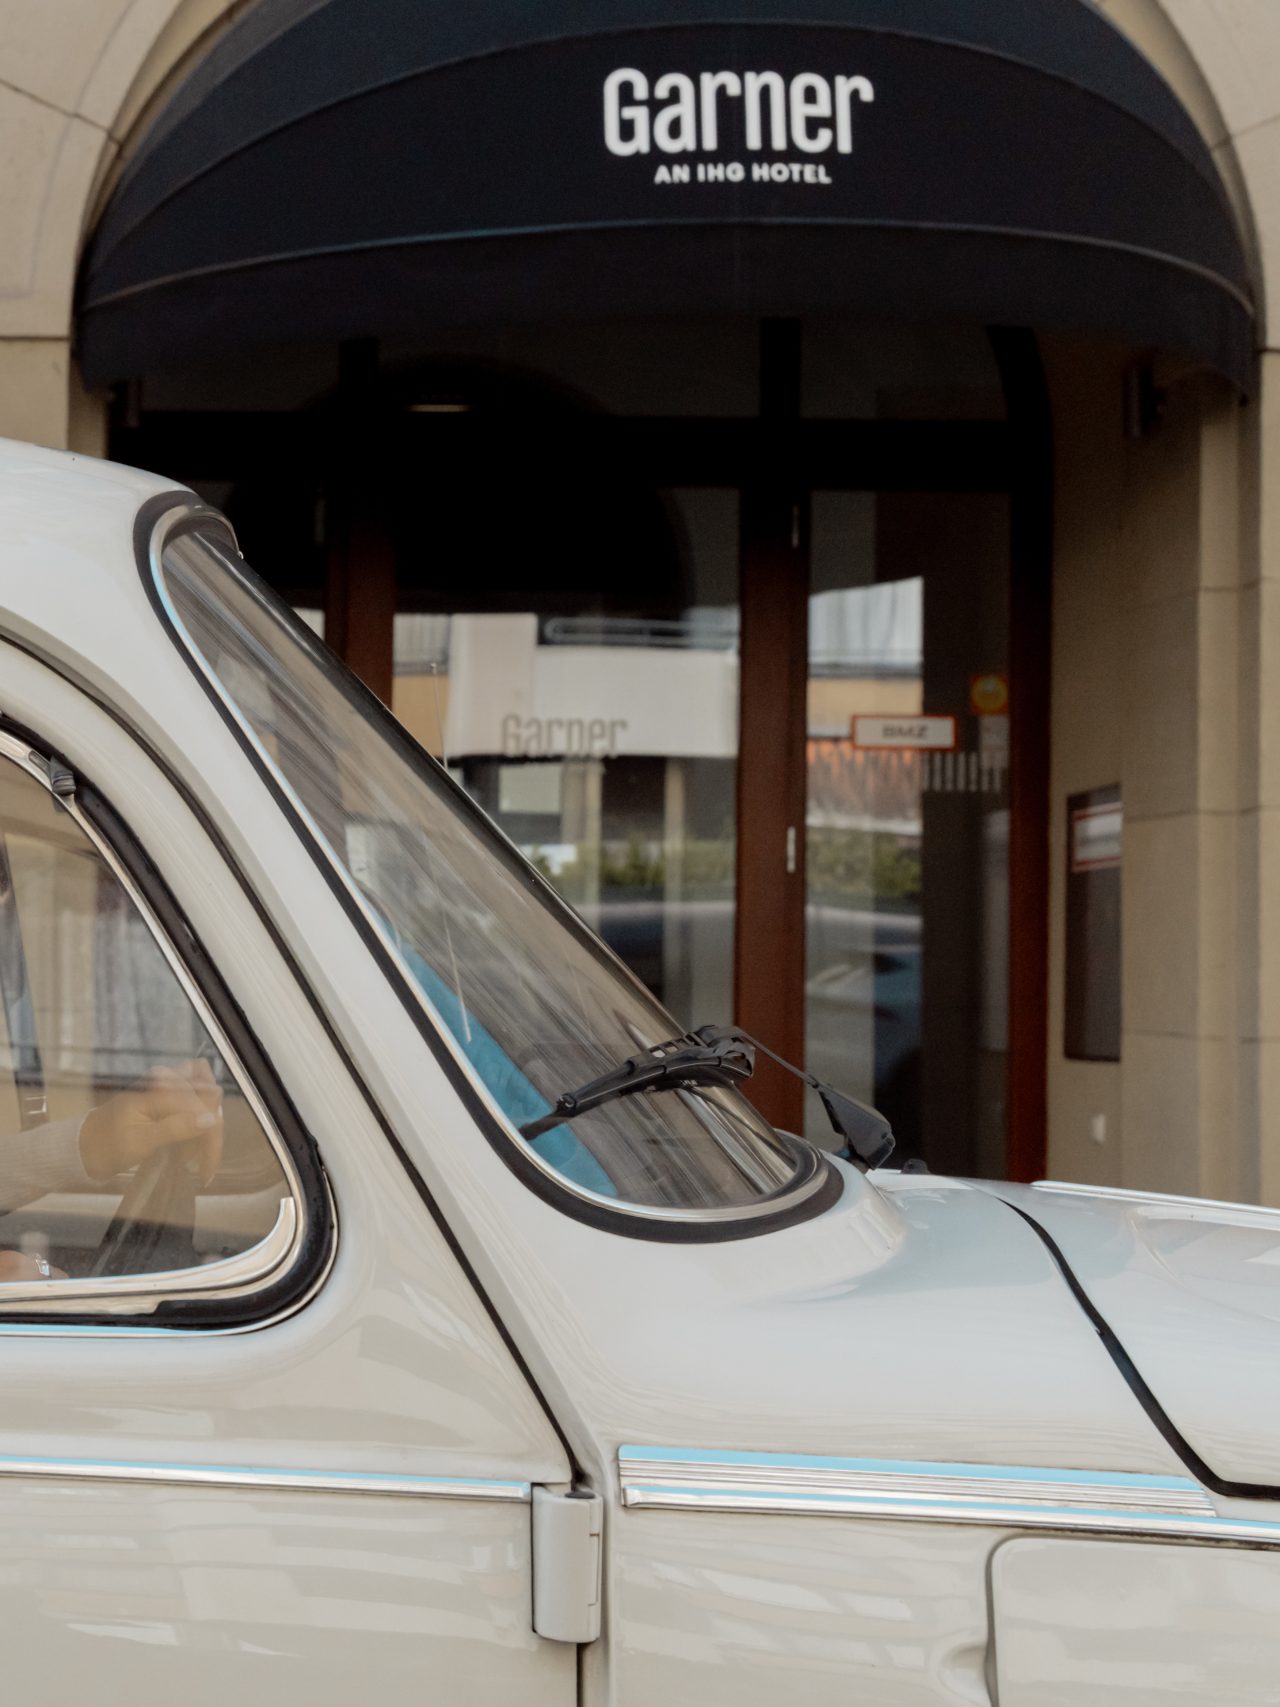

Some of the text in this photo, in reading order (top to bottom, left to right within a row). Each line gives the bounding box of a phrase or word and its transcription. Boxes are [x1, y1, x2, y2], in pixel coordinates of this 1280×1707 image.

[603, 67, 874, 156] Garner
[654, 162, 832, 184] AN IHG HOTEL
[501, 713, 628, 758] Garner
